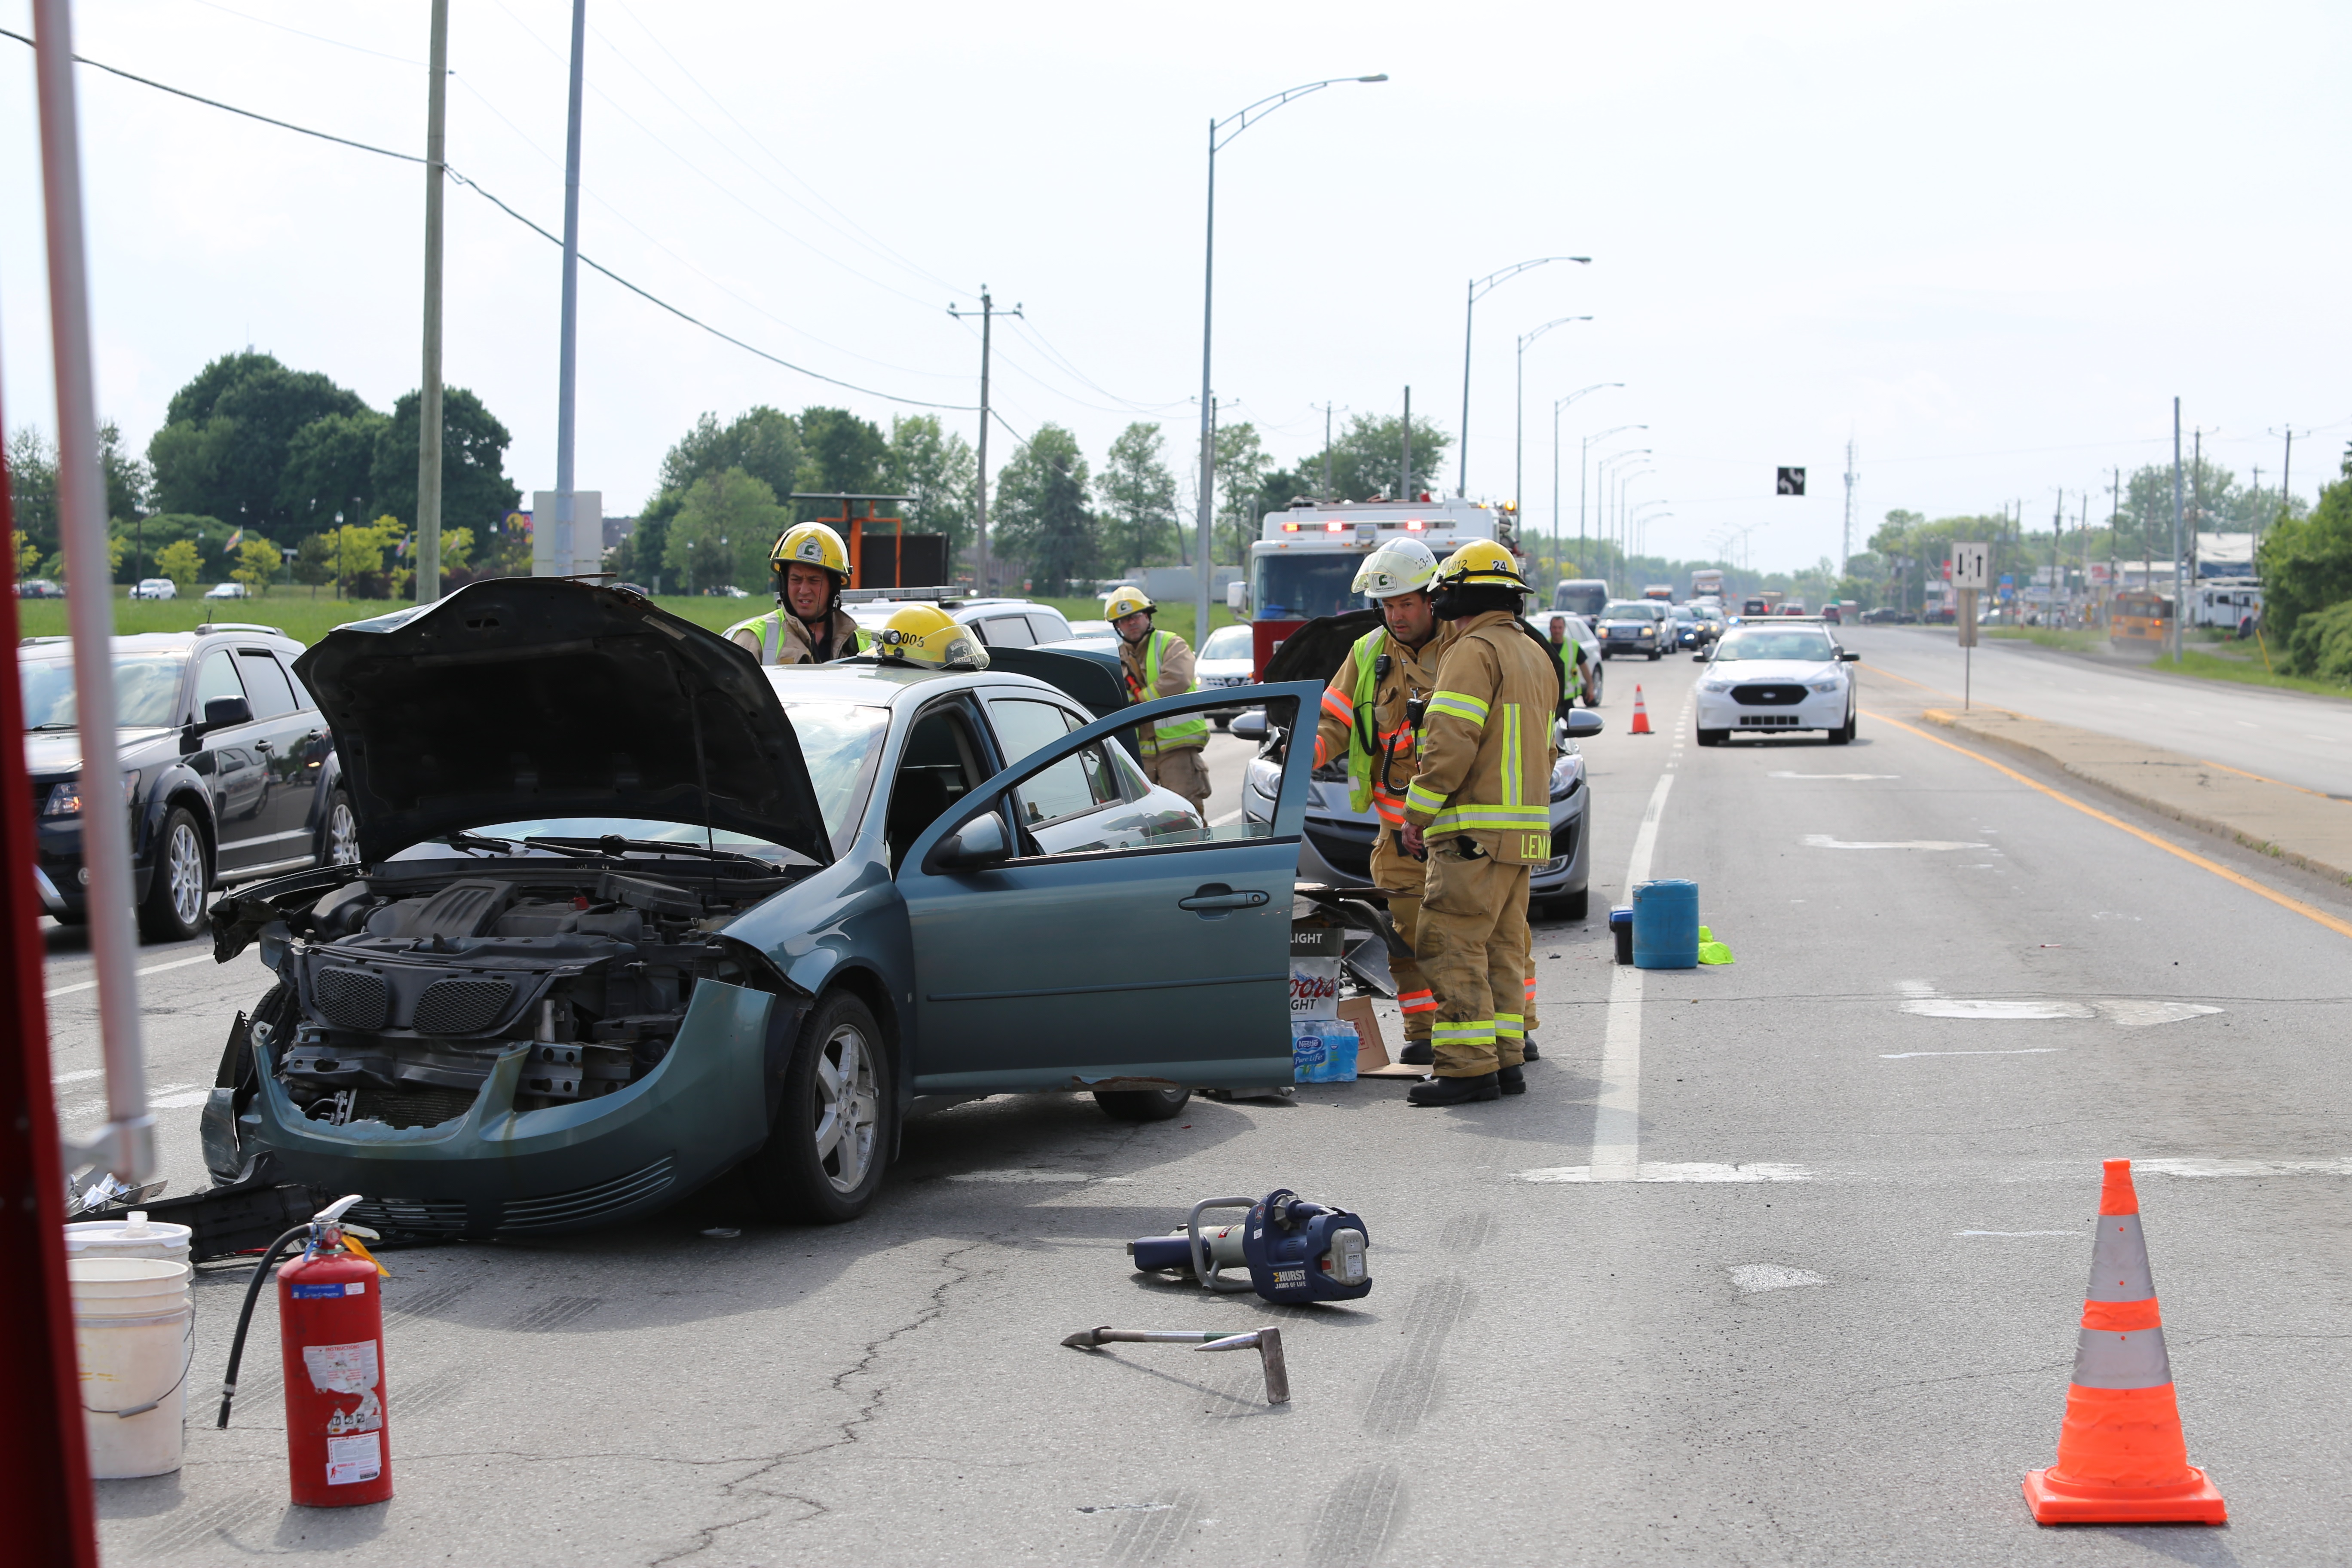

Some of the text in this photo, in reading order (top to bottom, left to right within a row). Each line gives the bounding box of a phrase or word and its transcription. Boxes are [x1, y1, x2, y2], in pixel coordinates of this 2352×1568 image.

[1493, 560, 1507, 571] 24
[962, 646, 968, 656] 5
[1290, 933, 1323, 943] LIGHT
[1289, 976, 1335, 998] oors
[1290, 998, 1317, 1010] GHT
[1298, 1039, 1319, 1047] Nestlé
[1295, 1057, 1309, 1065] Pure
[1309, 1053, 1323, 1062] Life
[1278, 1270, 1306, 1282] HURST
